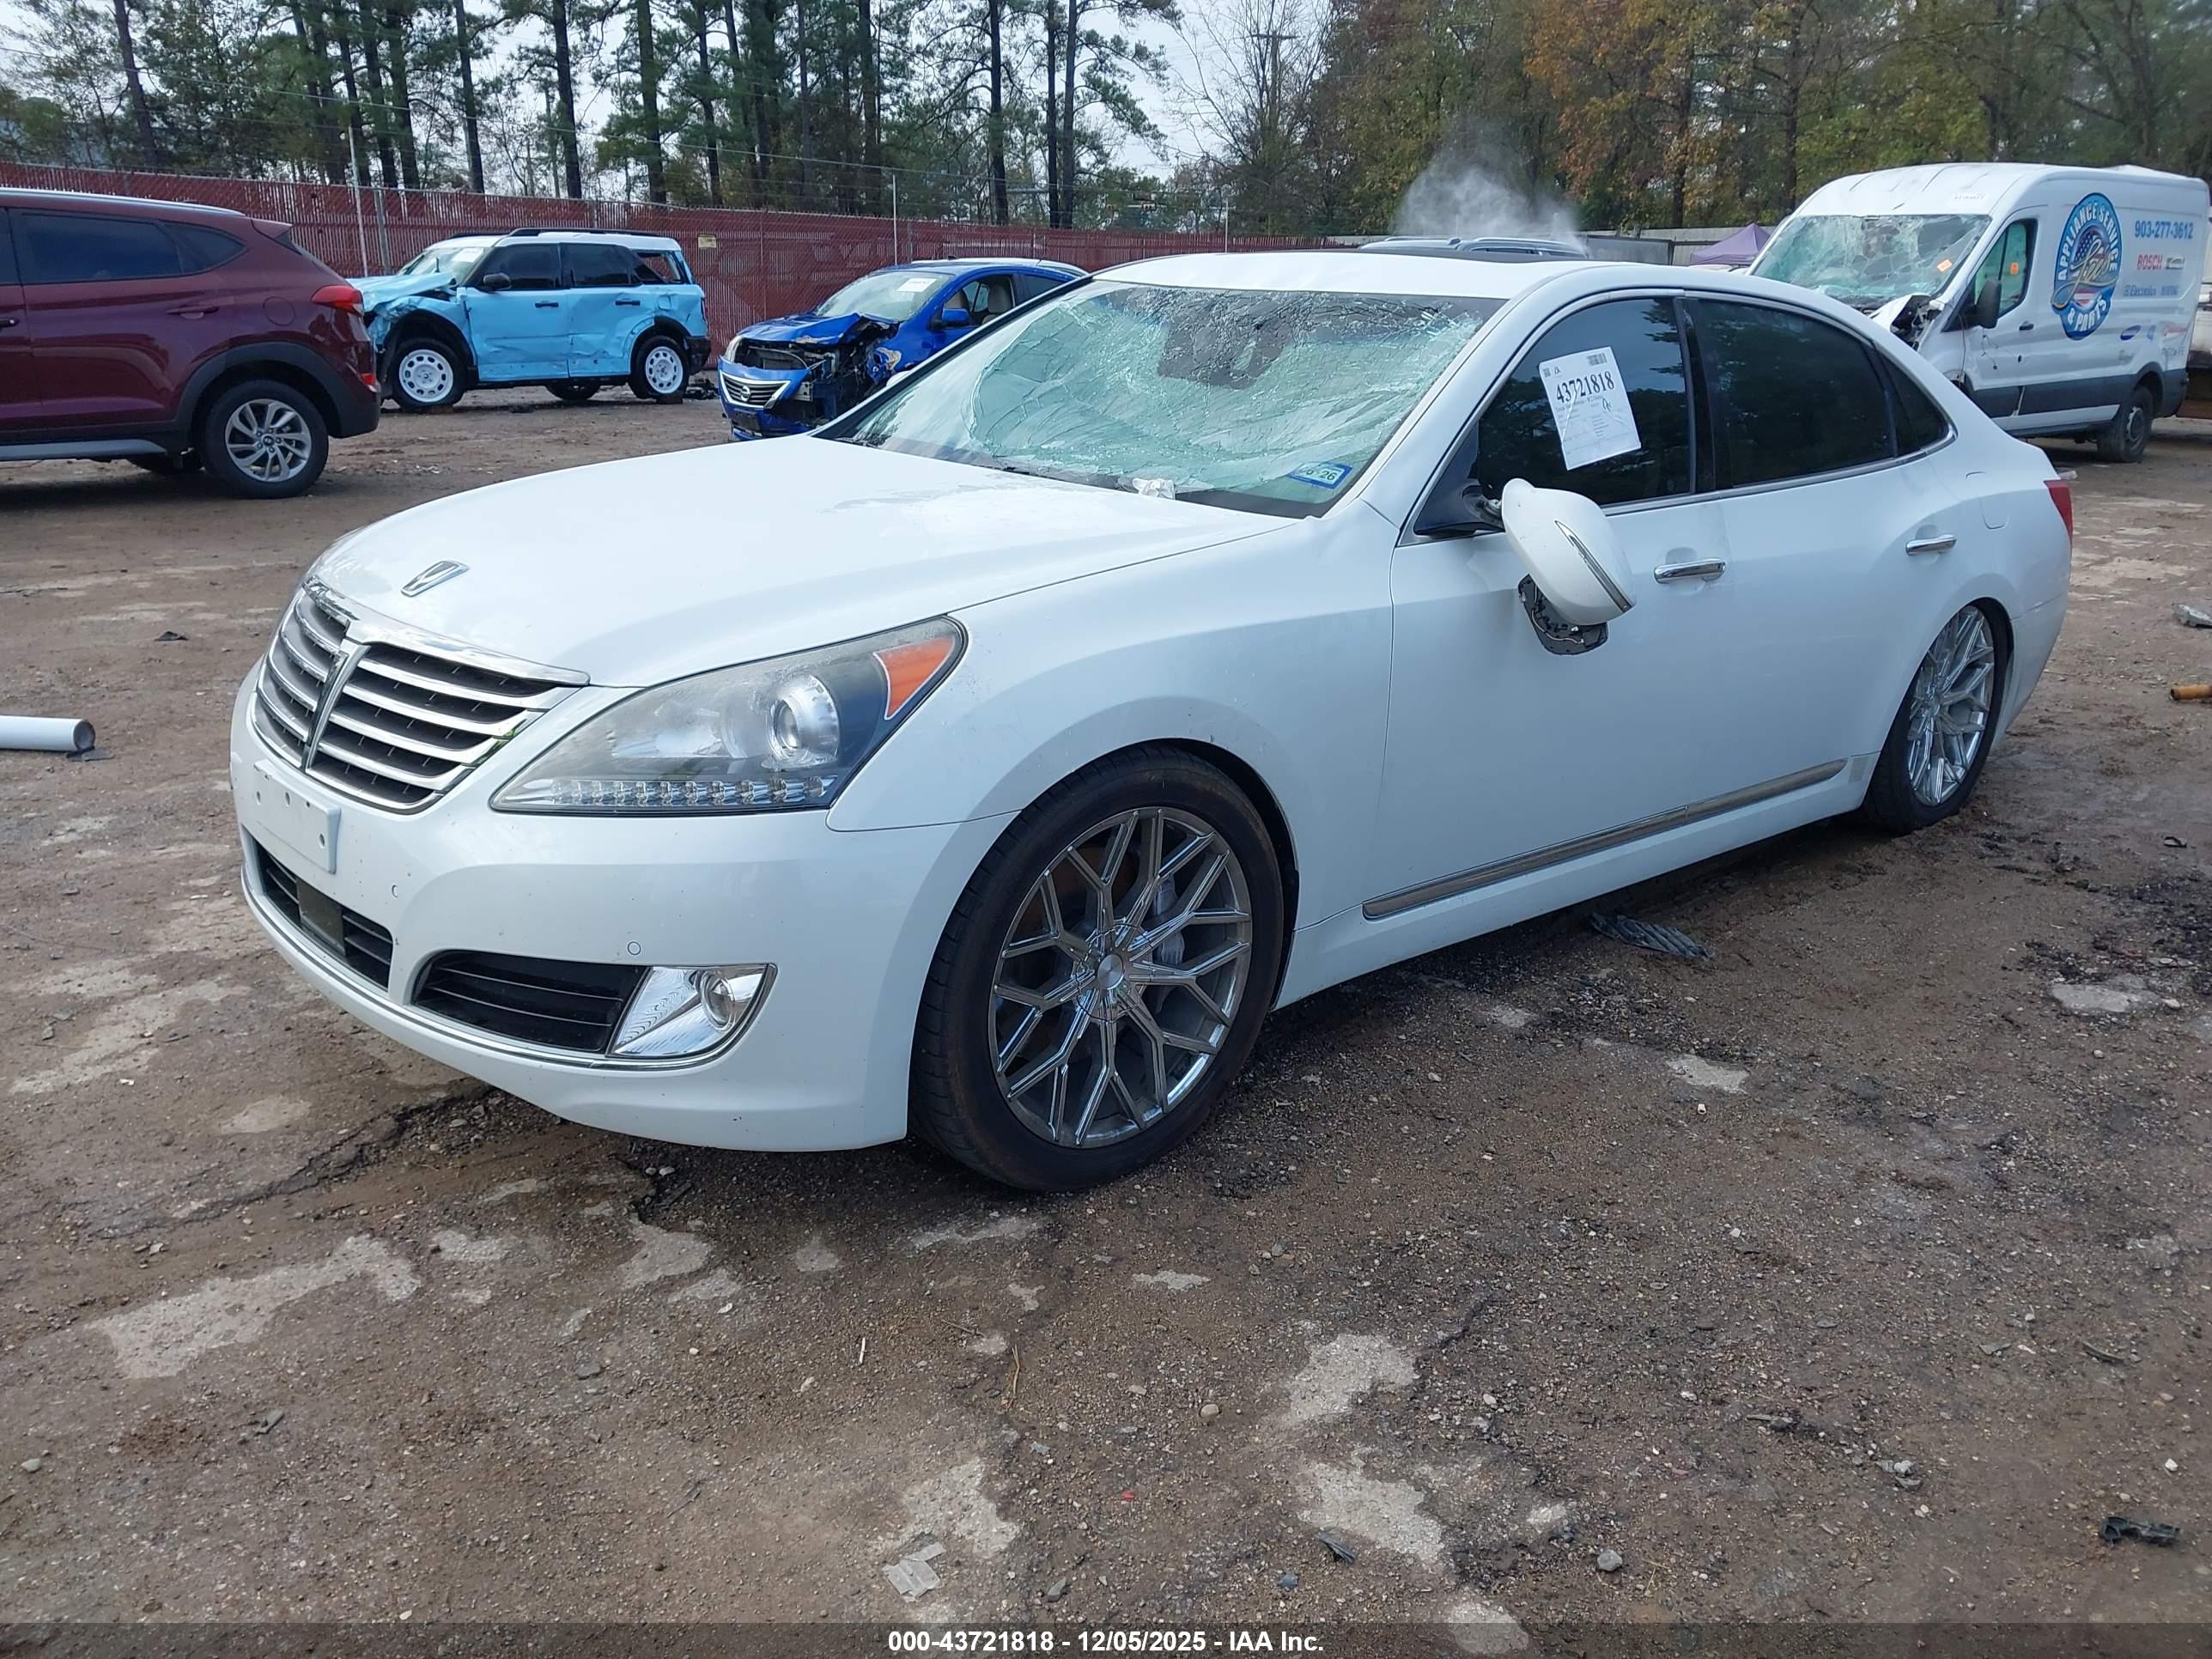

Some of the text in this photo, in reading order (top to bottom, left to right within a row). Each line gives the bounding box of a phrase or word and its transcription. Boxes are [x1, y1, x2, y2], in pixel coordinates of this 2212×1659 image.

[2057, 202, 2118, 280] APPLIANCE SERVICE
[2134, 219, 2193, 240] 903-277-3612
[2137, 254, 2163, 270] BOSCH
[2067, 295, 2106, 331] & PARTS
[1556, 370, 1614, 404] 43721818
[1319, 470, 1338, 481] 26
